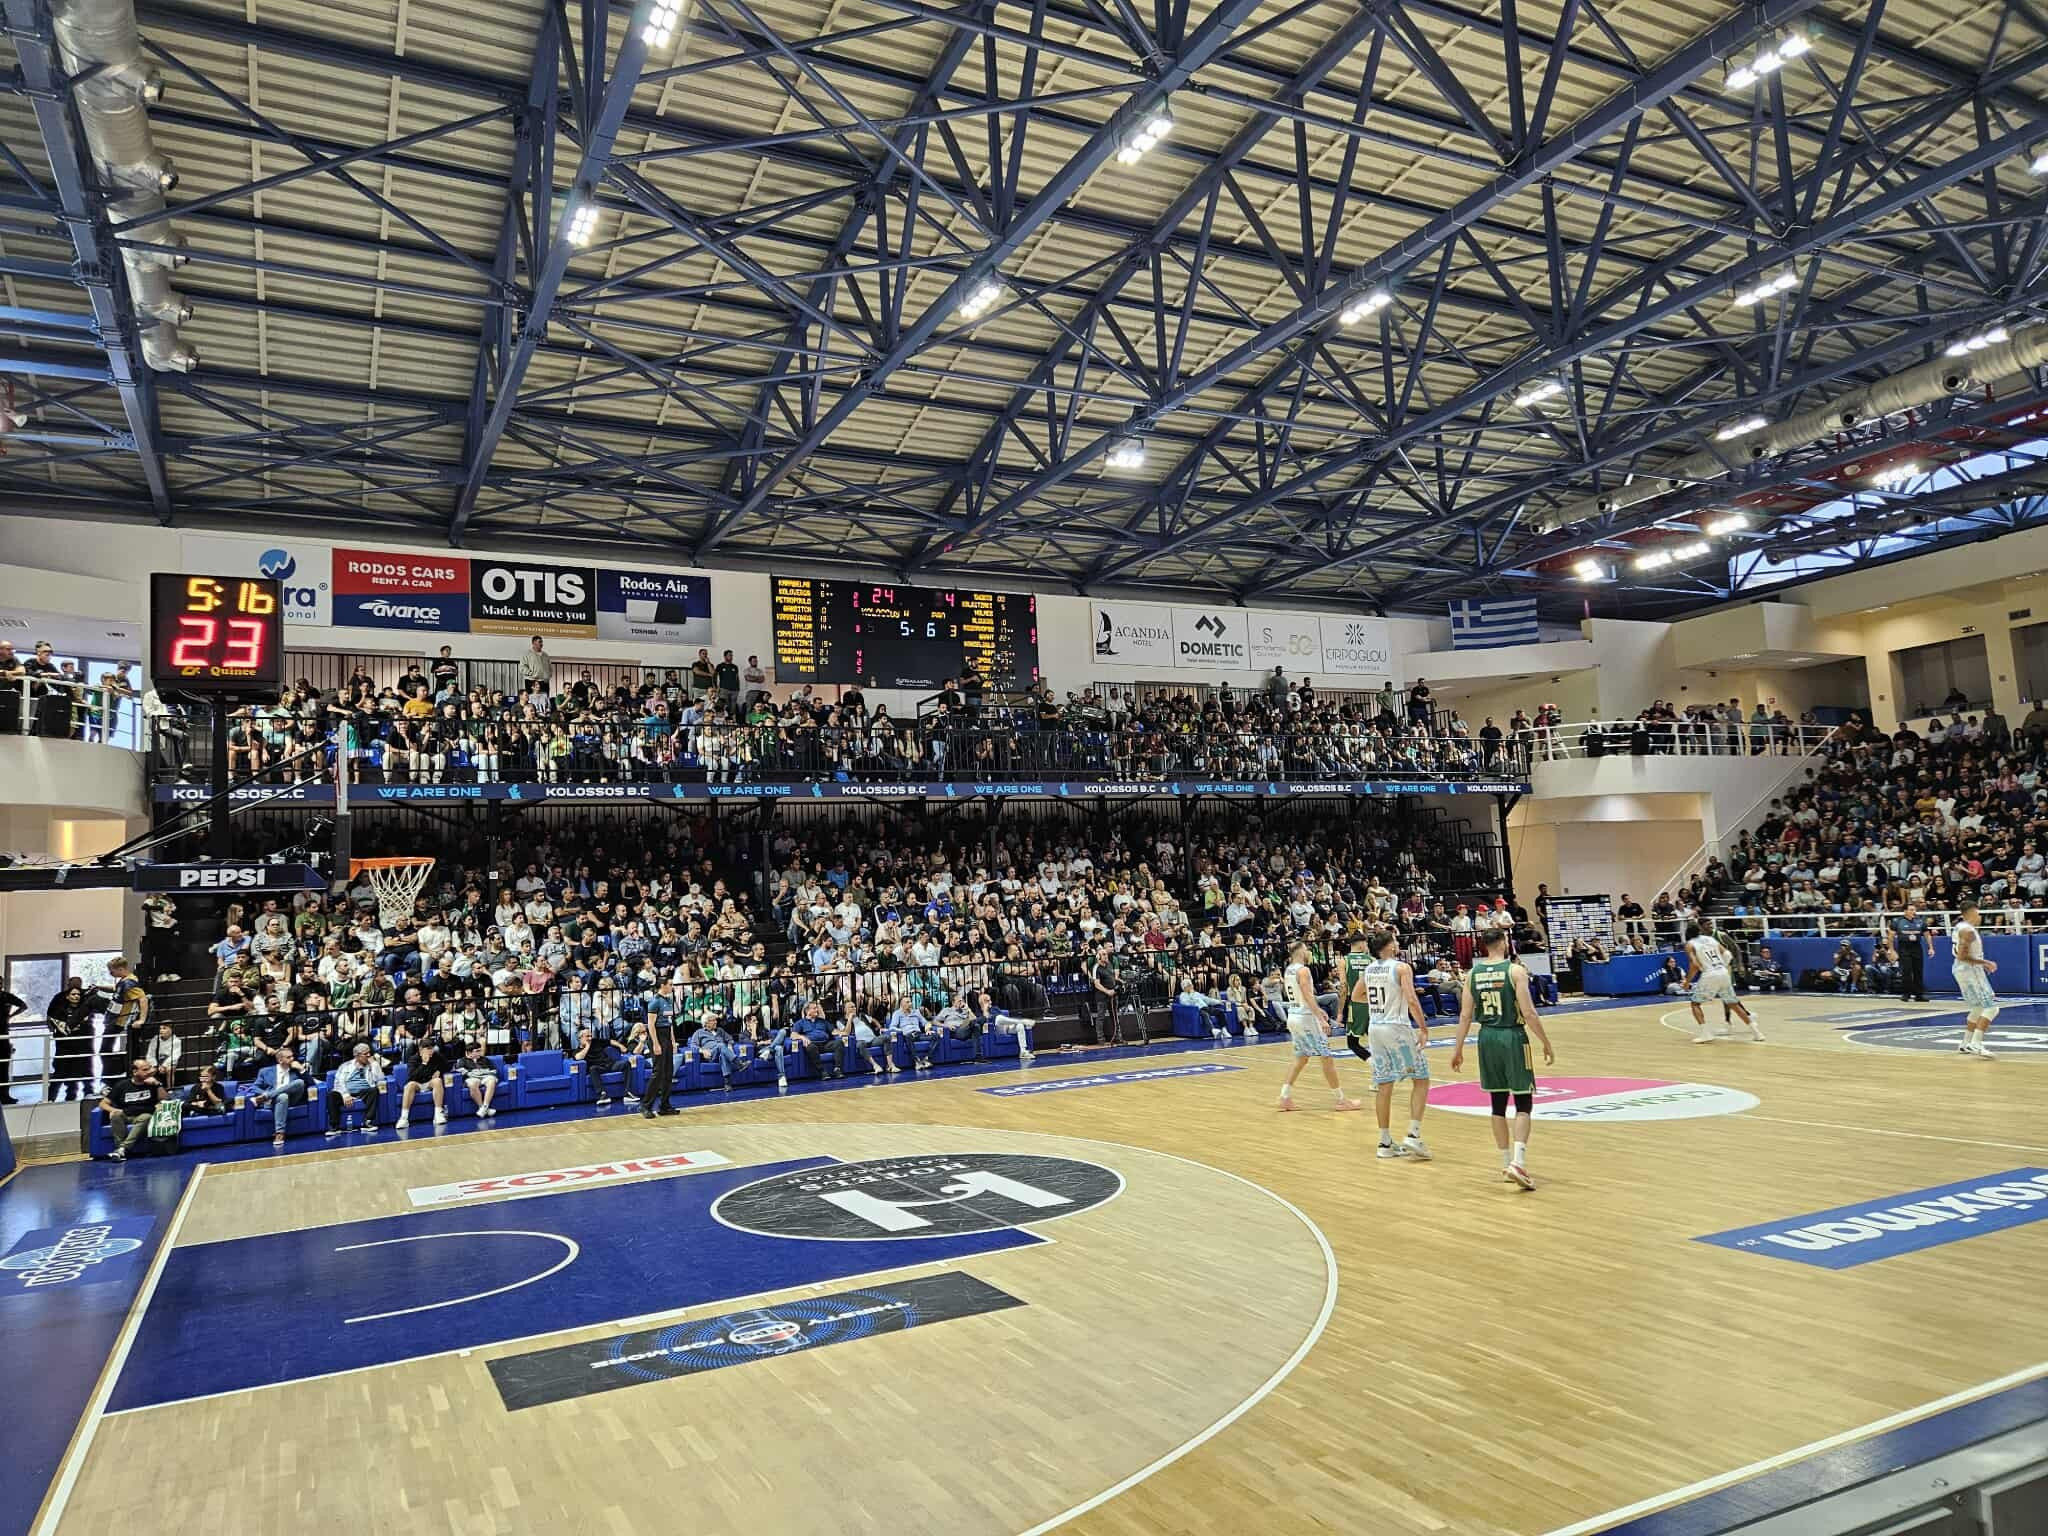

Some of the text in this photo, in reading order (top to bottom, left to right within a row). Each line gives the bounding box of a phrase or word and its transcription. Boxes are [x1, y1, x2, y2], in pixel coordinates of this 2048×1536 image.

[348, 561, 455, 580] RODOS CARS
[371, 577, 400, 586] RENT
[412, 580, 433, 588] CAR
[482, 568, 586, 606] OTIS
[620, 576, 662, 591] Rodos
[872, 588, 894, 604] 24
[373, 604, 440, 620] avance
[482, 604, 586, 621] Made to move you
[1115, 626, 1170, 640] ACANDIA
[172, 617, 265, 668] 23
[1180, 641, 1243, 657] DOMETIC
[378, 787, 481, 798] WE ARE ONE
[545, 787, 624, 796] KOLOSSOS
[708, 786, 791, 795] WE ARE ONE
[842, 786, 906, 795] KOLOSSOS
[975, 785, 1042, 793] WE ARE ONE
[1084, 785, 1138, 793] KOLOSSOS
[1195, 784, 1255, 792] WE ARE ONE
[1386, 784, 1436, 792] WE ARE ONE
[180, 868, 266, 887] PEPSI
[1368, 986, 1386, 1005] 21
[1481, 991, 1503, 1016] 24
[800, 1162, 970, 1192] HOTELS
[589, 1301, 910, 1369] THIRSTY PEPSI FOR MORE
